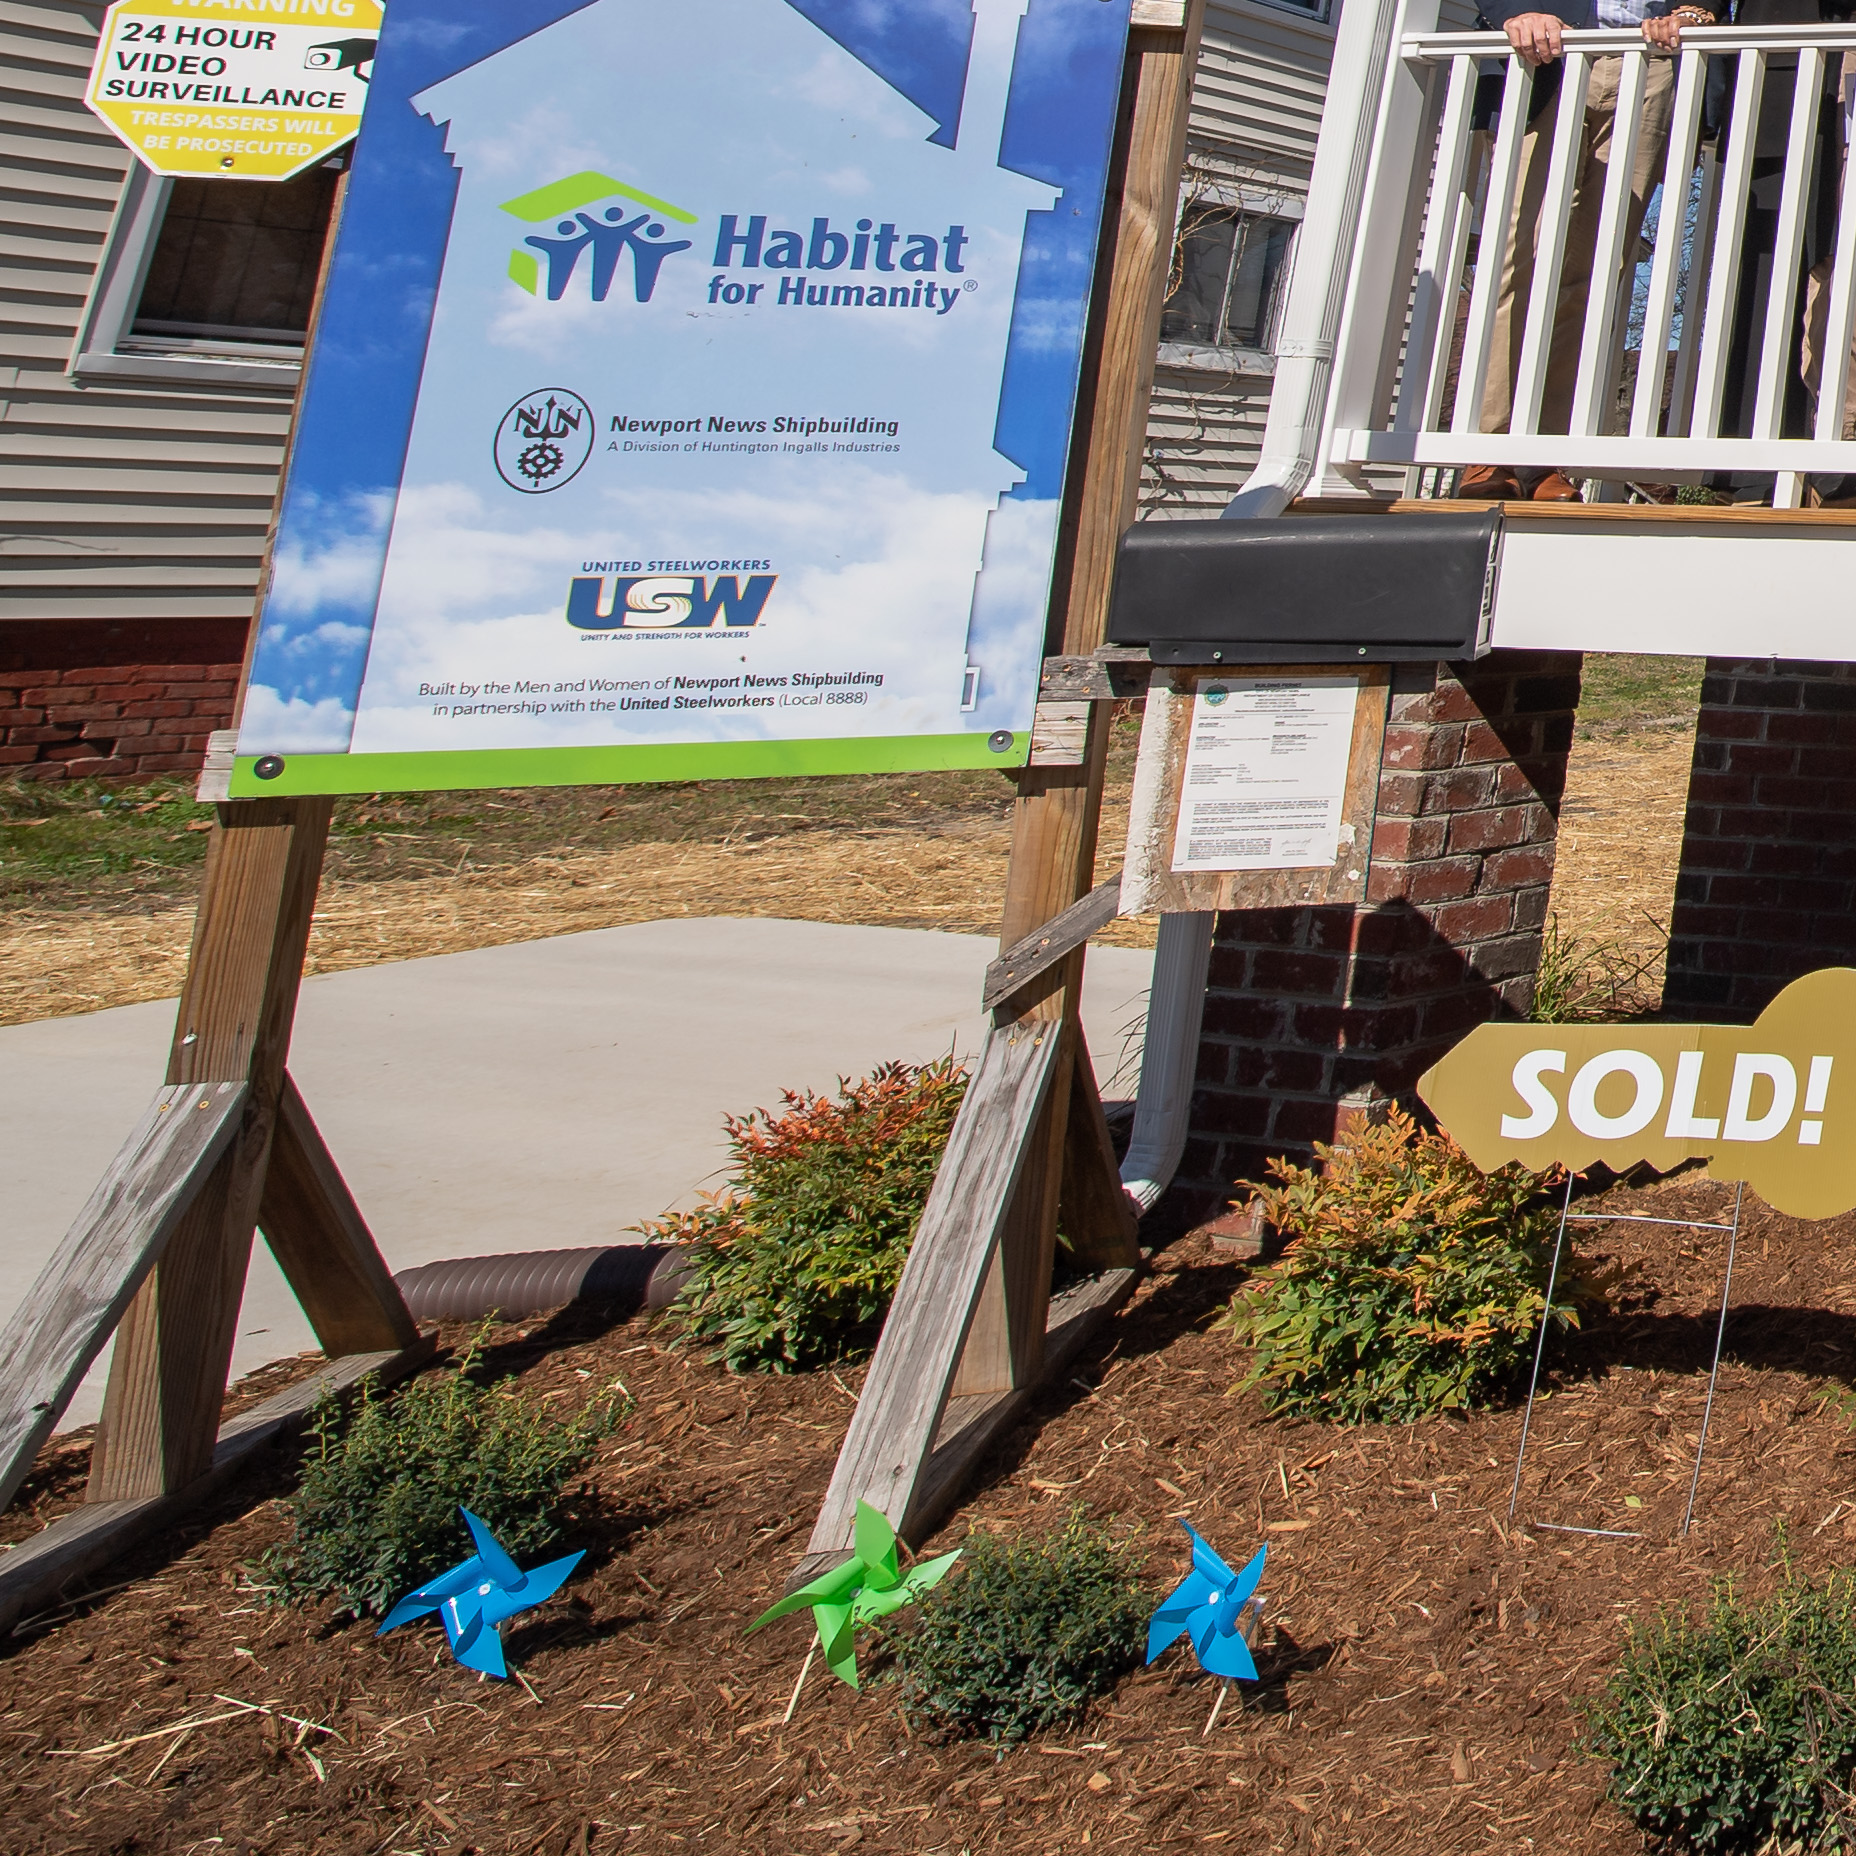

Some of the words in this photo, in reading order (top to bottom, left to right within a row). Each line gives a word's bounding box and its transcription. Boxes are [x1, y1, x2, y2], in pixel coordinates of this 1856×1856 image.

[121, 22, 166, 43] 24
[174, 25, 277, 50] HOUR
[116, 51, 227, 76] VIDEO
[105, 79, 347, 109] SURVEILLANCE
[130, 110, 279, 132] TRESPASSERS
[283, 118, 337, 135] WILL
[143, 135, 171, 150] BE
[175, 136, 313, 157] PROSECUTED
[712, 214, 969, 273] Habitat
[707, 274, 764, 304] for
[610, 415, 702, 436] Newport
[707, 416, 767, 433] News
[772, 416, 900, 437] Shipbuilding
[606, 441, 618, 452] A
[623, 441, 680, 452] Division
[684, 441, 699, 452] of
[701, 441, 778, 455] Huntington
[782, 441, 829, 455] Ingalls
[833, 442, 900, 453] Industries
[582, 561, 642, 572] UNITED
[647, 560, 771, 571] STEELWORKERS
[565, 574, 780, 630] USW
[581, 633, 609, 642] UNITY
[611, 632, 632, 641] AND
[635, 632, 683, 641] STRENGTH
[684, 631, 703, 639] FOR
[705, 631, 750, 640] WORKERS
[419, 682, 456, 696] Built
[459, 681, 481, 698] by
[483, 681, 511, 694] the
[513, 680, 551, 694] Men
[553, 679, 586, 693] and
[588, 679, 650, 692] Women
[653, 676, 673, 690] of
[673, 676, 741, 691] Newport
[743, 674, 789, 688] News
[791, 671, 885, 689] Shipbuilding
[433, 704, 449, 716] in
[451, 700, 547, 718] partnership
[550, 699, 586, 713] with
[589, 698, 617, 712] the
[619, 696, 670, 711] United
[673, 694, 775, 709] Steelworkers
[778, 693, 823, 707] (Local
[825, 691, 869, 706] 8888)
[1500, 1048, 1834, 1145] SOLD!
